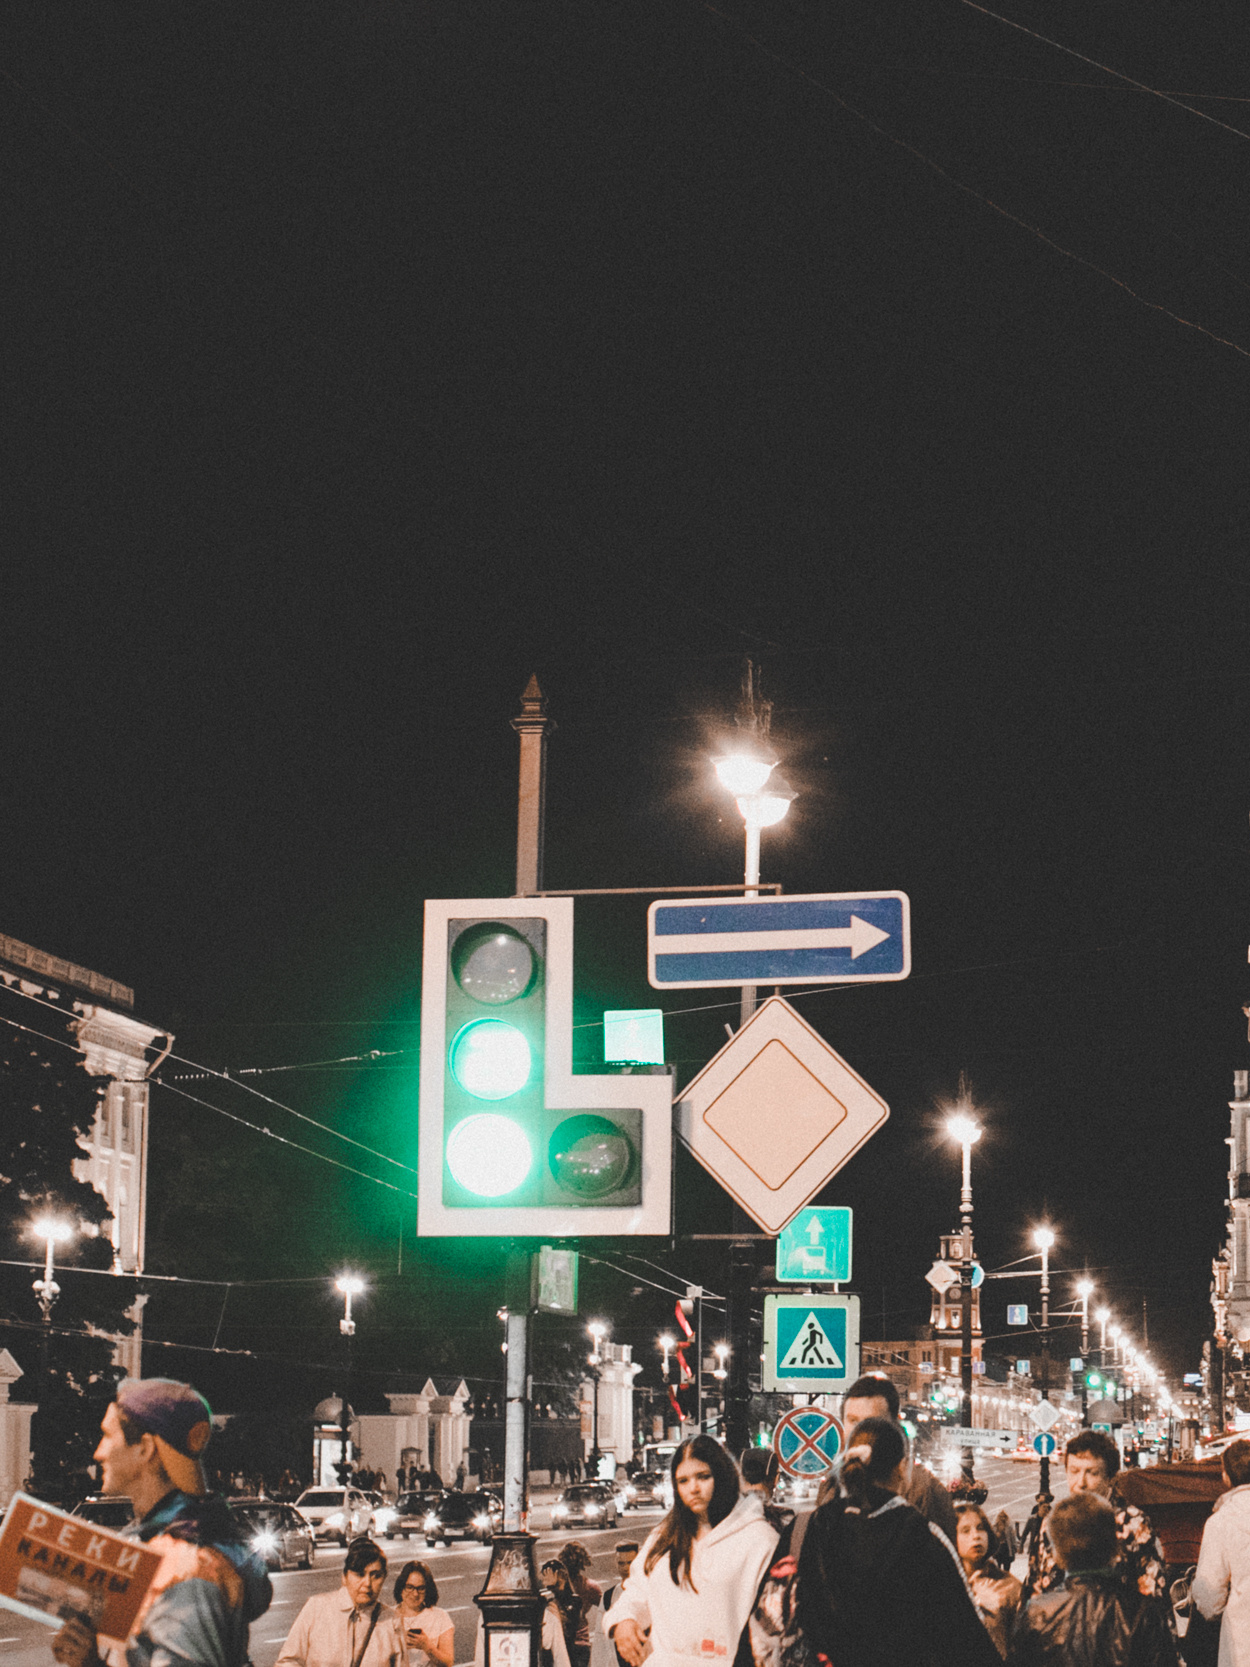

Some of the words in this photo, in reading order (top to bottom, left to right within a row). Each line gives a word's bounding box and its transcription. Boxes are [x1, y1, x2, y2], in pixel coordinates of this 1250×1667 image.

[945, 1429, 996, 1437] КАРАВАННАЯ
[18, 1537, 130, 1594] КАНАЛЫ
[28, 1511, 141, 1572] РЕКИ
